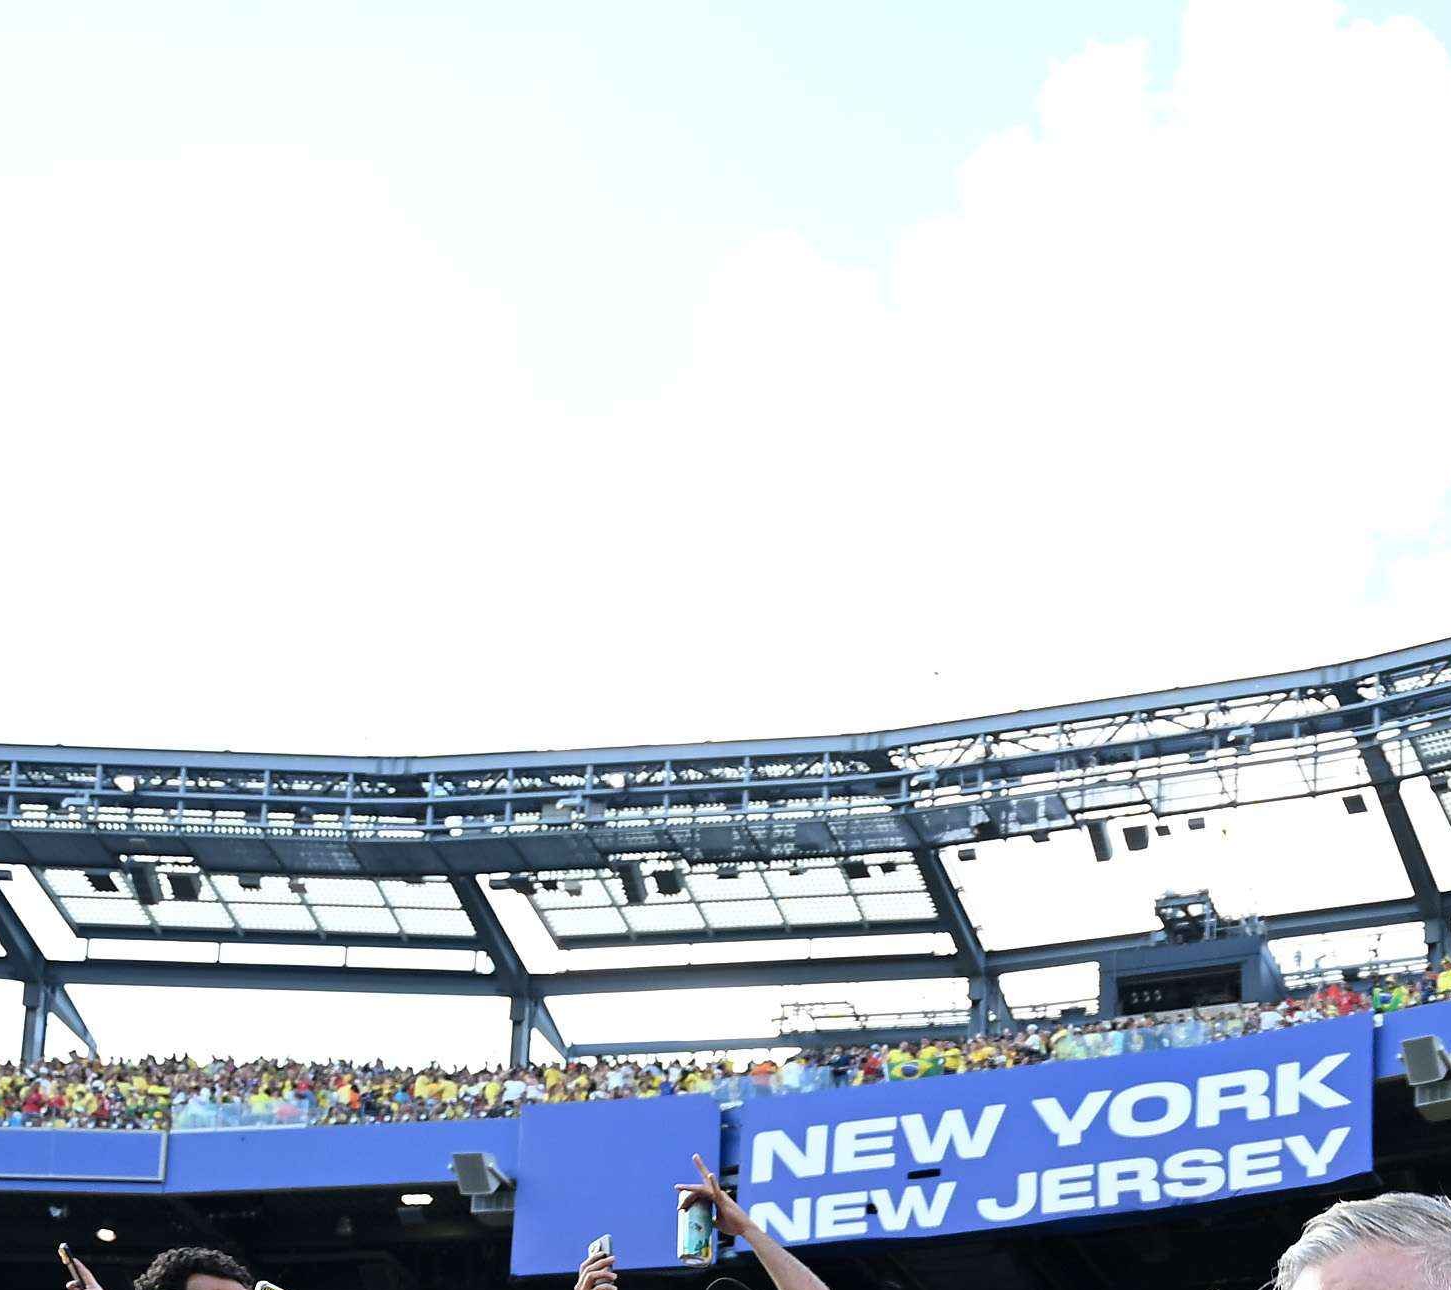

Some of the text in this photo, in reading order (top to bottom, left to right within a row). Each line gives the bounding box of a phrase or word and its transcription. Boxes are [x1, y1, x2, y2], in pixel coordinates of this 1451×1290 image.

[751, 1053, 1352, 1184] NEW YORK
[749, 1126, 1352, 1242] NEW JERSEY
